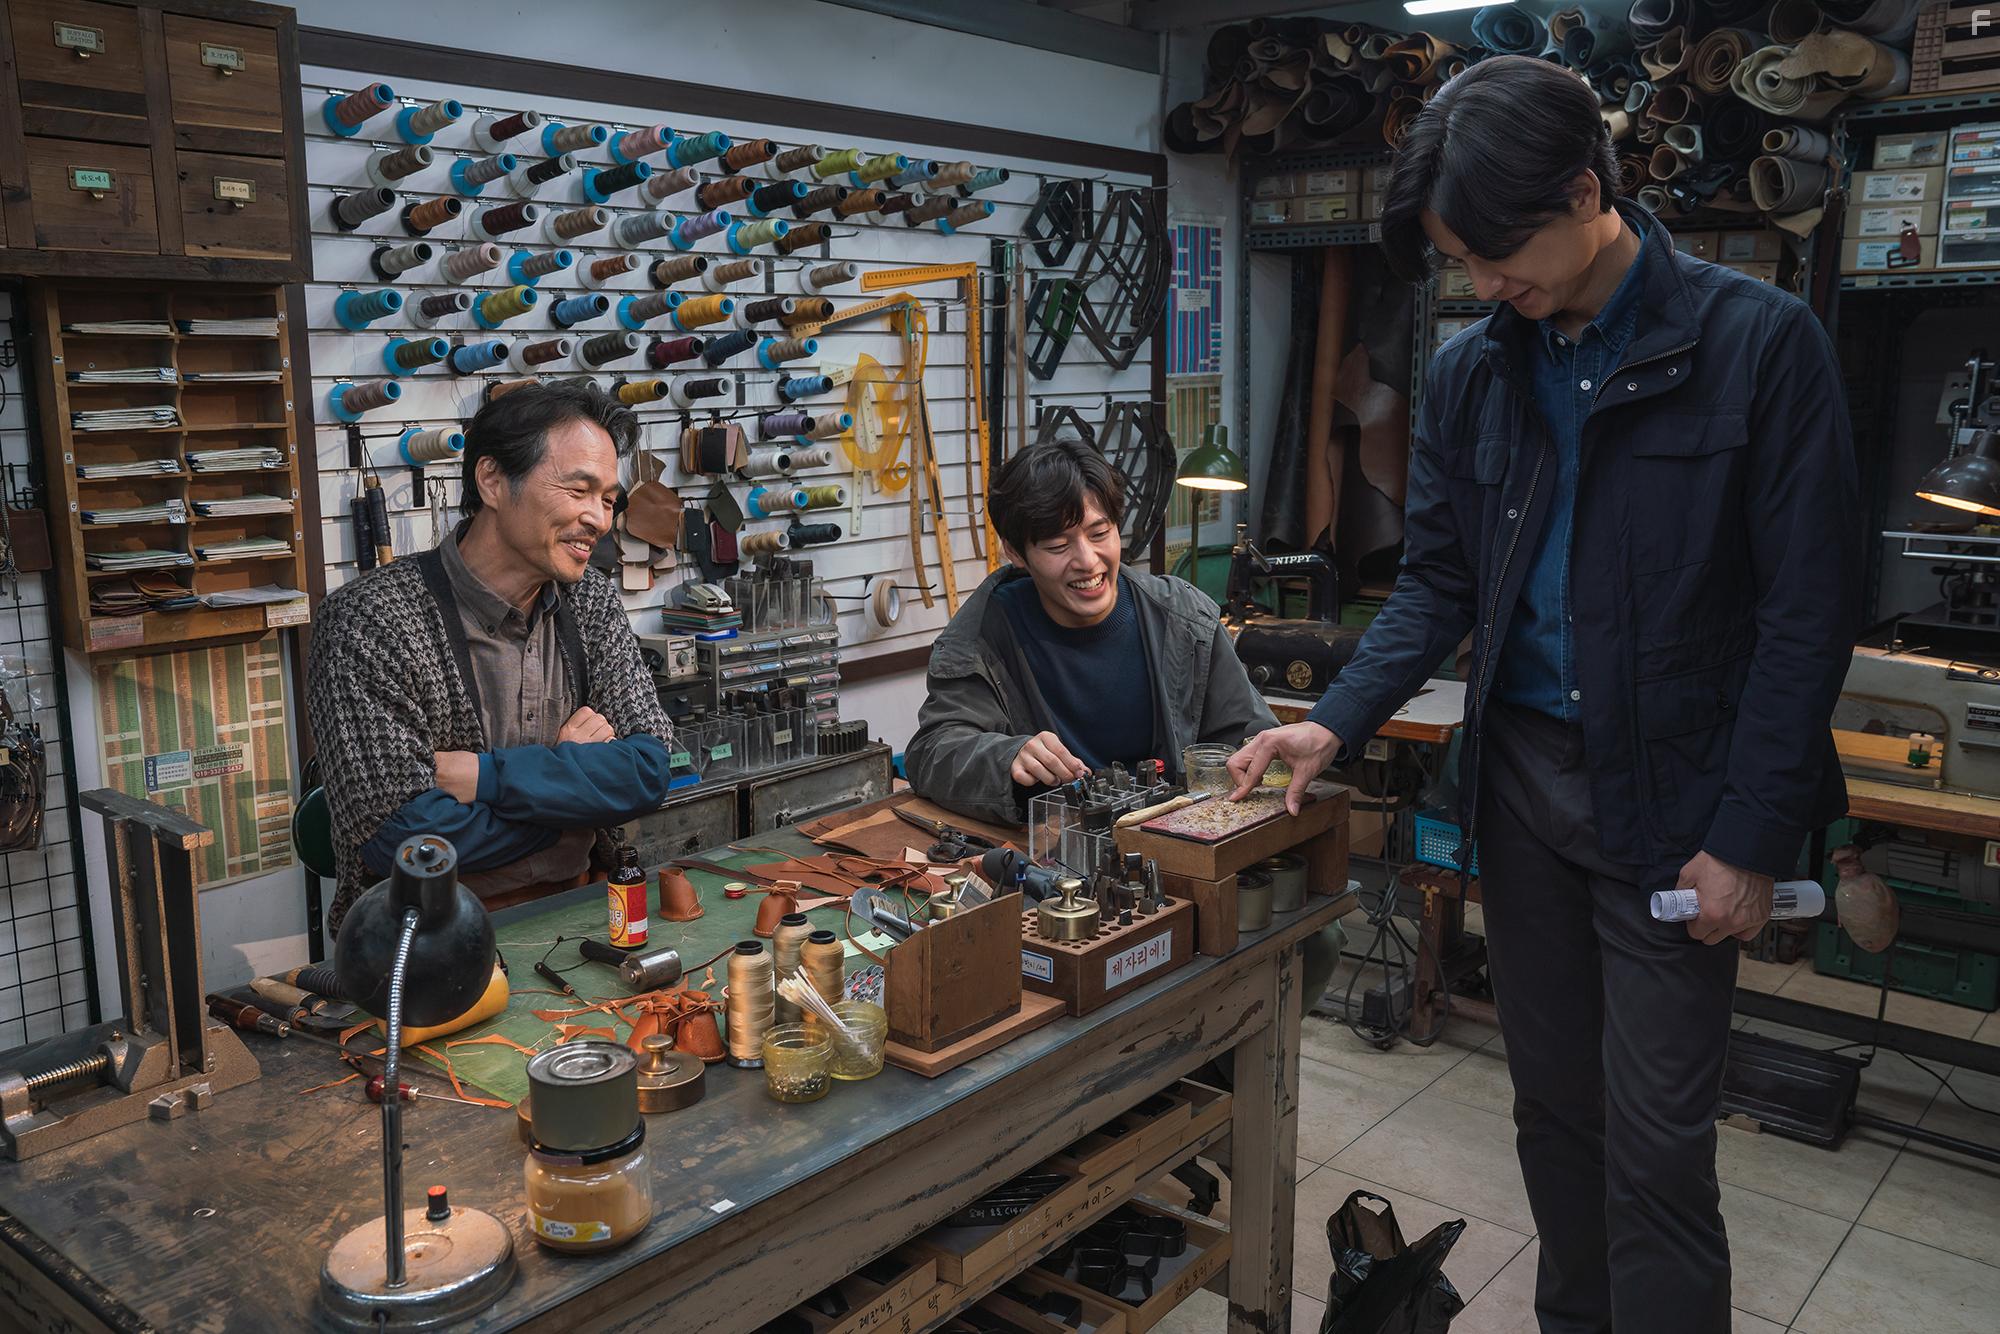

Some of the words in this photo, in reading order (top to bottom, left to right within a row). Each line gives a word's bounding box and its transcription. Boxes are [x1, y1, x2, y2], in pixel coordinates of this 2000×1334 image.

[1275, 554, 1312, 565] NIPPY
[1971, 708, 2000, 716] TOYOT
[1111, 939, 1166, 977] 제자리에!
